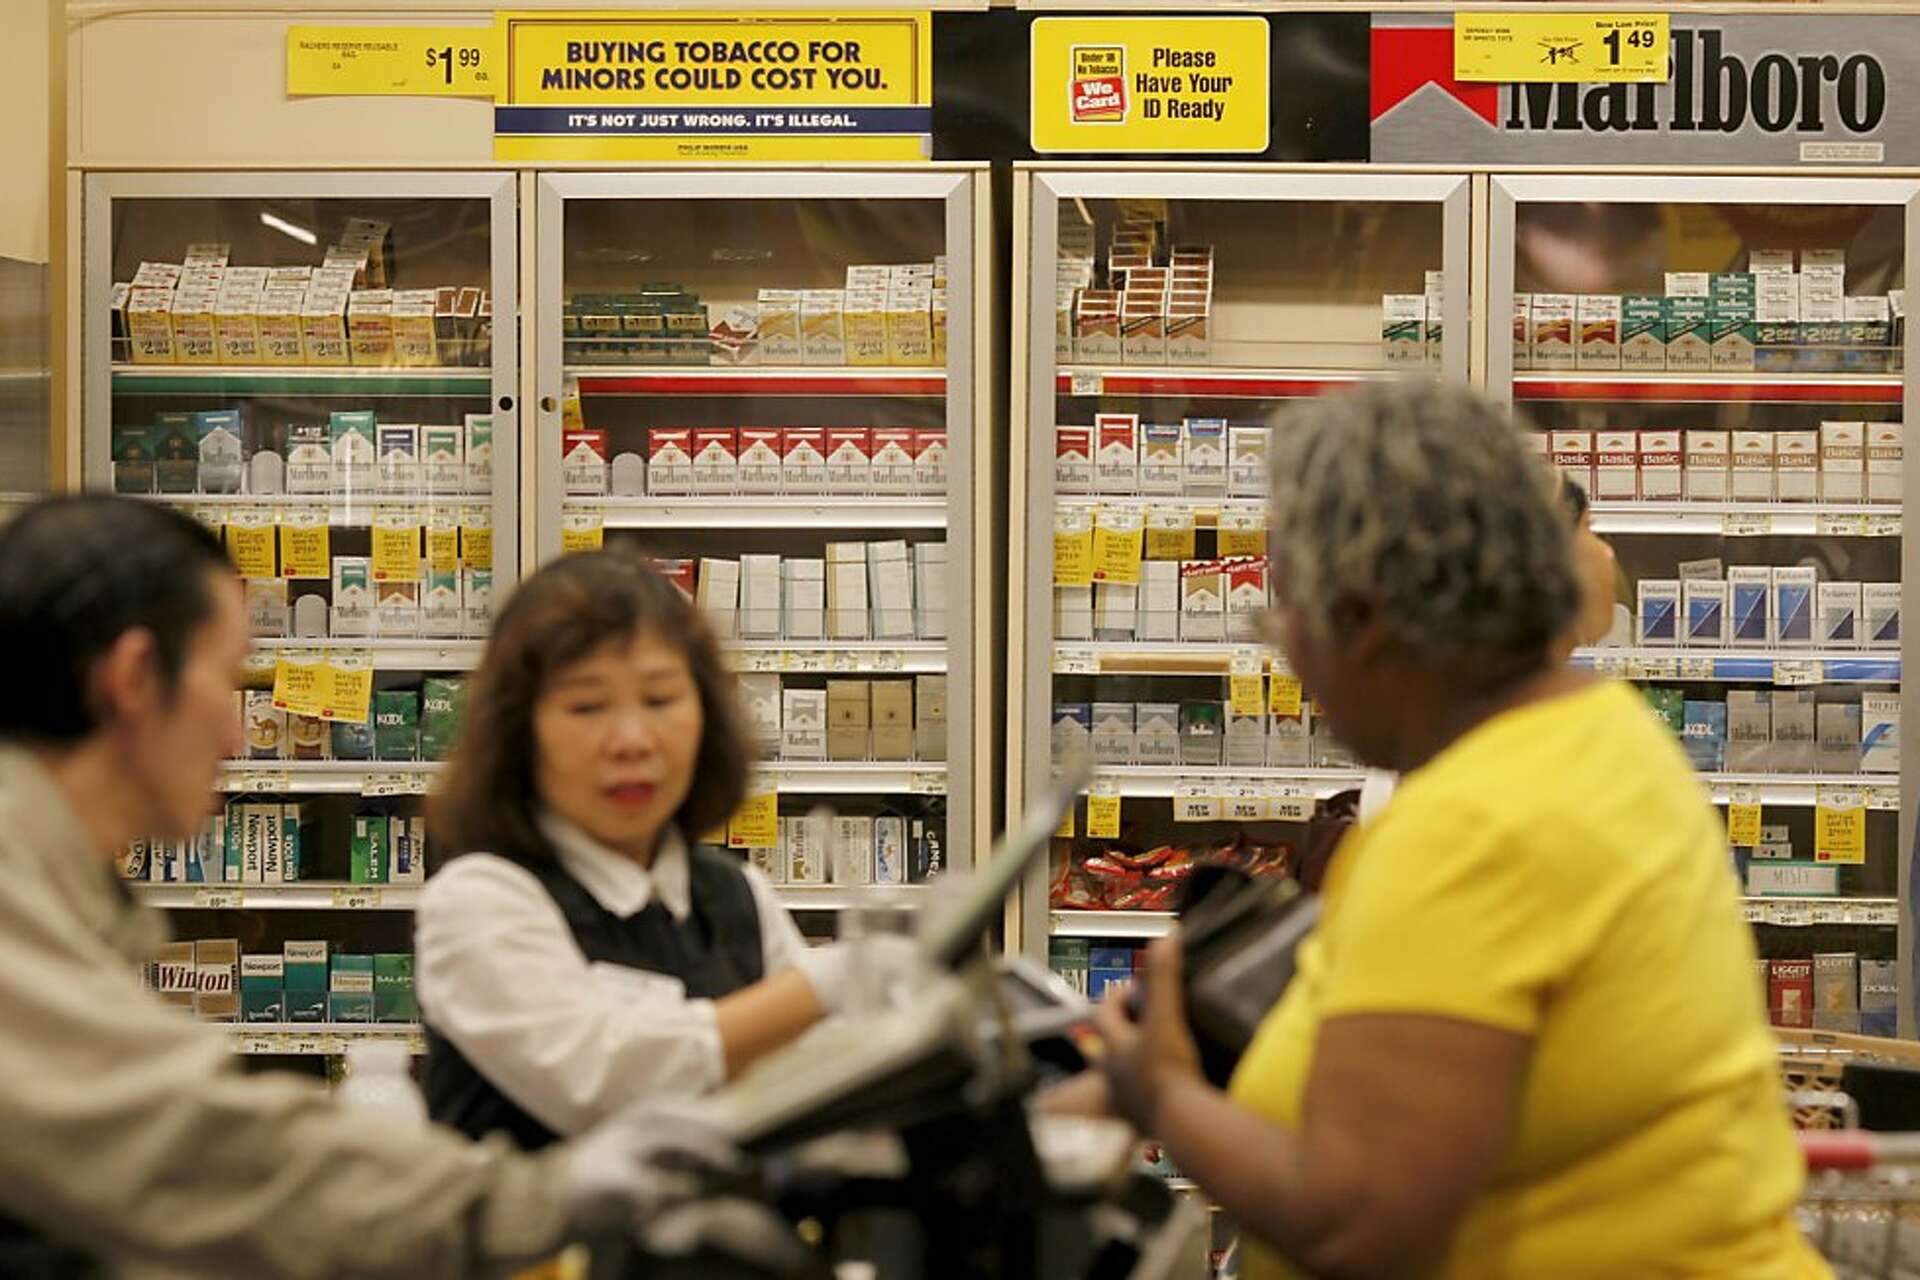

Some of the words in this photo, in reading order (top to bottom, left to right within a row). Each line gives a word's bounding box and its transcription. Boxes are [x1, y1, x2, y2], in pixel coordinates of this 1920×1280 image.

[567, 42, 666, 63] BUYING
[674, 42, 800, 63] TOBACCO
[808, 42, 861, 63] FOR
[1152, 48, 1216, 68] Please
[541, 68, 645, 90] MINORS
[655, 68, 742, 90] COULD
[751, 68, 817, 90] COST
[826, 68, 888, 90] YOU.
[1136, 73, 1182, 93] Have
[1188, 73, 1233, 93] Your
[1081, 81, 1114, 97] We
[1076, 93, 1121, 110] Card
[1143, 98, 1161, 118] ID
[1167, 98, 1225, 121] Ready
[568, 114, 598, 127] IT'S
[601, 114, 636, 127] NOT
[639, 114, 680, 127] JUST
[683, 114, 751, 127] WRONG.
[755, 114, 785, 127] IT'S
[788, 114, 858, 127] ILLEGAL.
[1643, 453, 1678, 465] Basic
[1824, 447, 1860, 458] Basic
[1554, 454, 1589, 465] Basic
[1599, 454, 1634, 465] Basic
[1689, 454, 1725, 466] Basic
[1735, 454, 1770, 466] Basic
[1780, 454, 1815, 466] Basic
[378, 713, 405, 726] KOOL
[247, 813, 260, 871] Newport
[266, 815, 280, 873] Newport
[924, 831, 940, 879] CAMEL
[286, 948, 323, 960] Newport
[243, 962, 281, 974] Newport
[1773, 966, 1810, 976] LIGGETT
[376, 975, 411, 983] SALE
